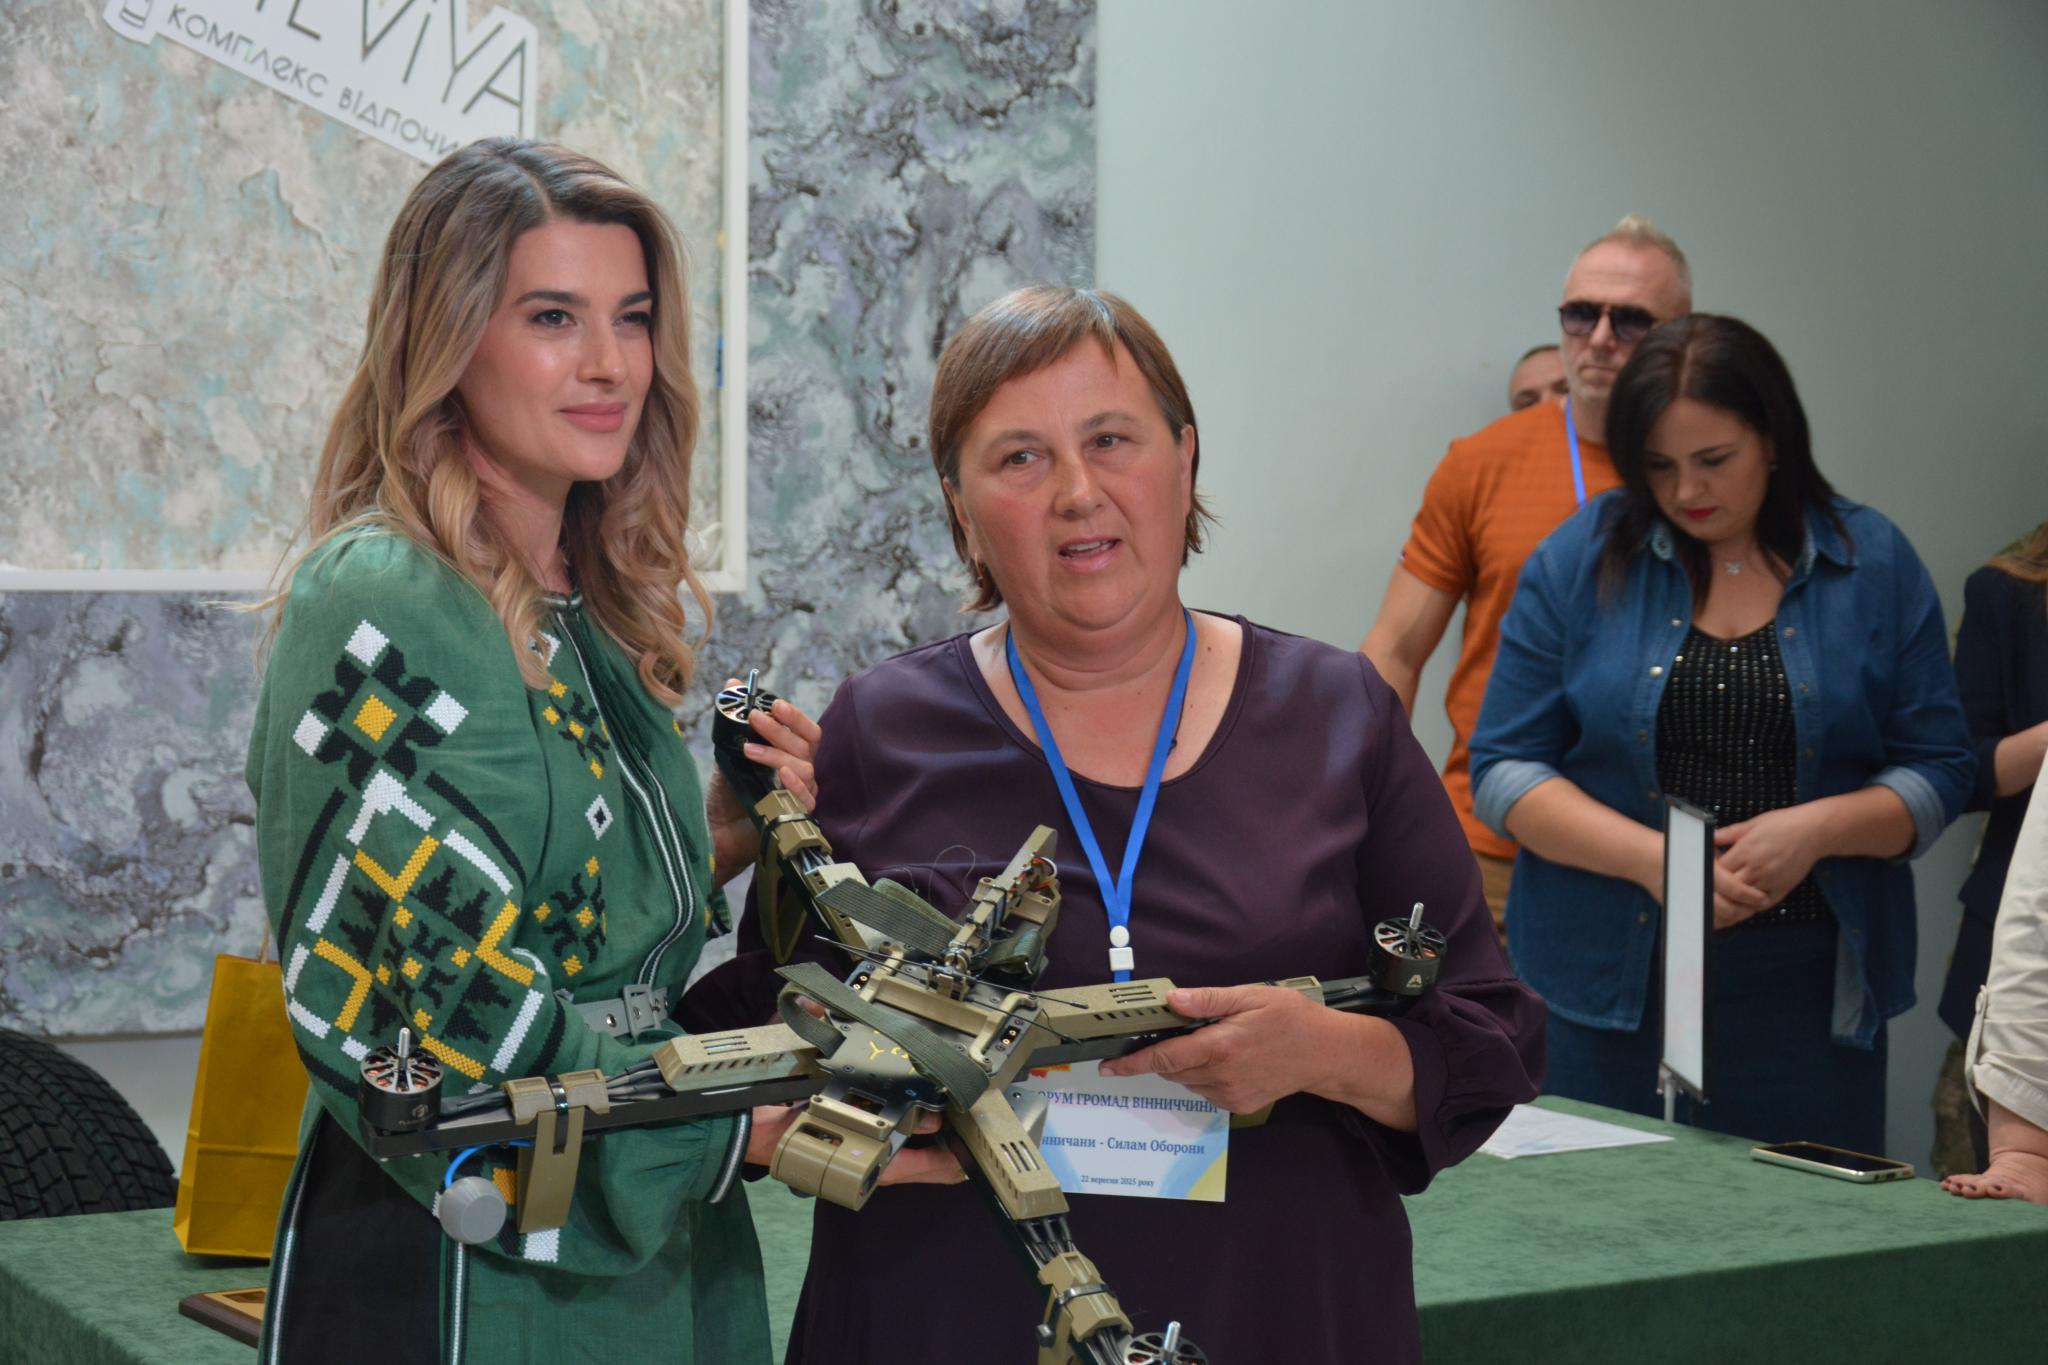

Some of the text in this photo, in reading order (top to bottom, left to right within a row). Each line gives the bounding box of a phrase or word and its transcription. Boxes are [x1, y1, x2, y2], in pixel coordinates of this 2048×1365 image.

[1077, 1092, 1129, 1109] ГРОМАД
[1107, 1137, 1147, 1151] Силам
[1150, 1139, 1205, 1155] Оборони
[1081, 1175, 1154, 1188] 22 вересня 2025 року
